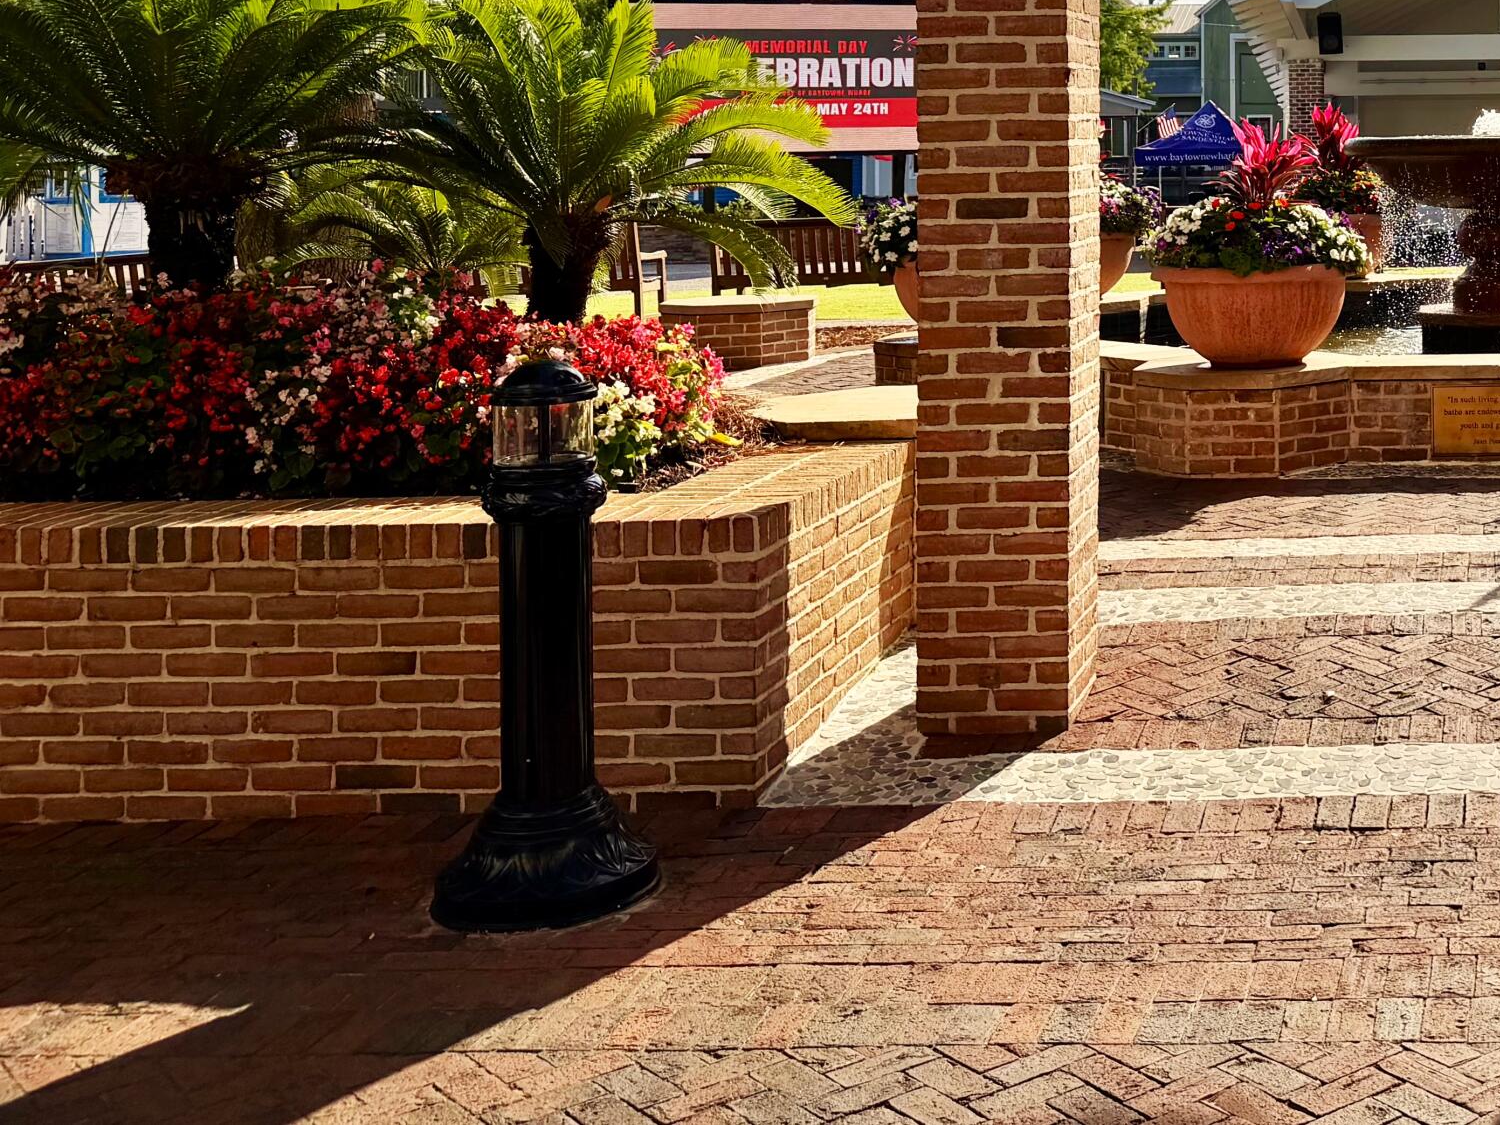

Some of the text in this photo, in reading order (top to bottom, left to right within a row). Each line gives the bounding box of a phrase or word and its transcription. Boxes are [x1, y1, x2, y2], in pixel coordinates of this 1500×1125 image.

[745, 40, 868, 54] MEMORIAL DAY
[738, 57, 915, 88] EBRATION
[817, 103, 848, 115] MAY
[853, 103, 889, 115] 24TH
